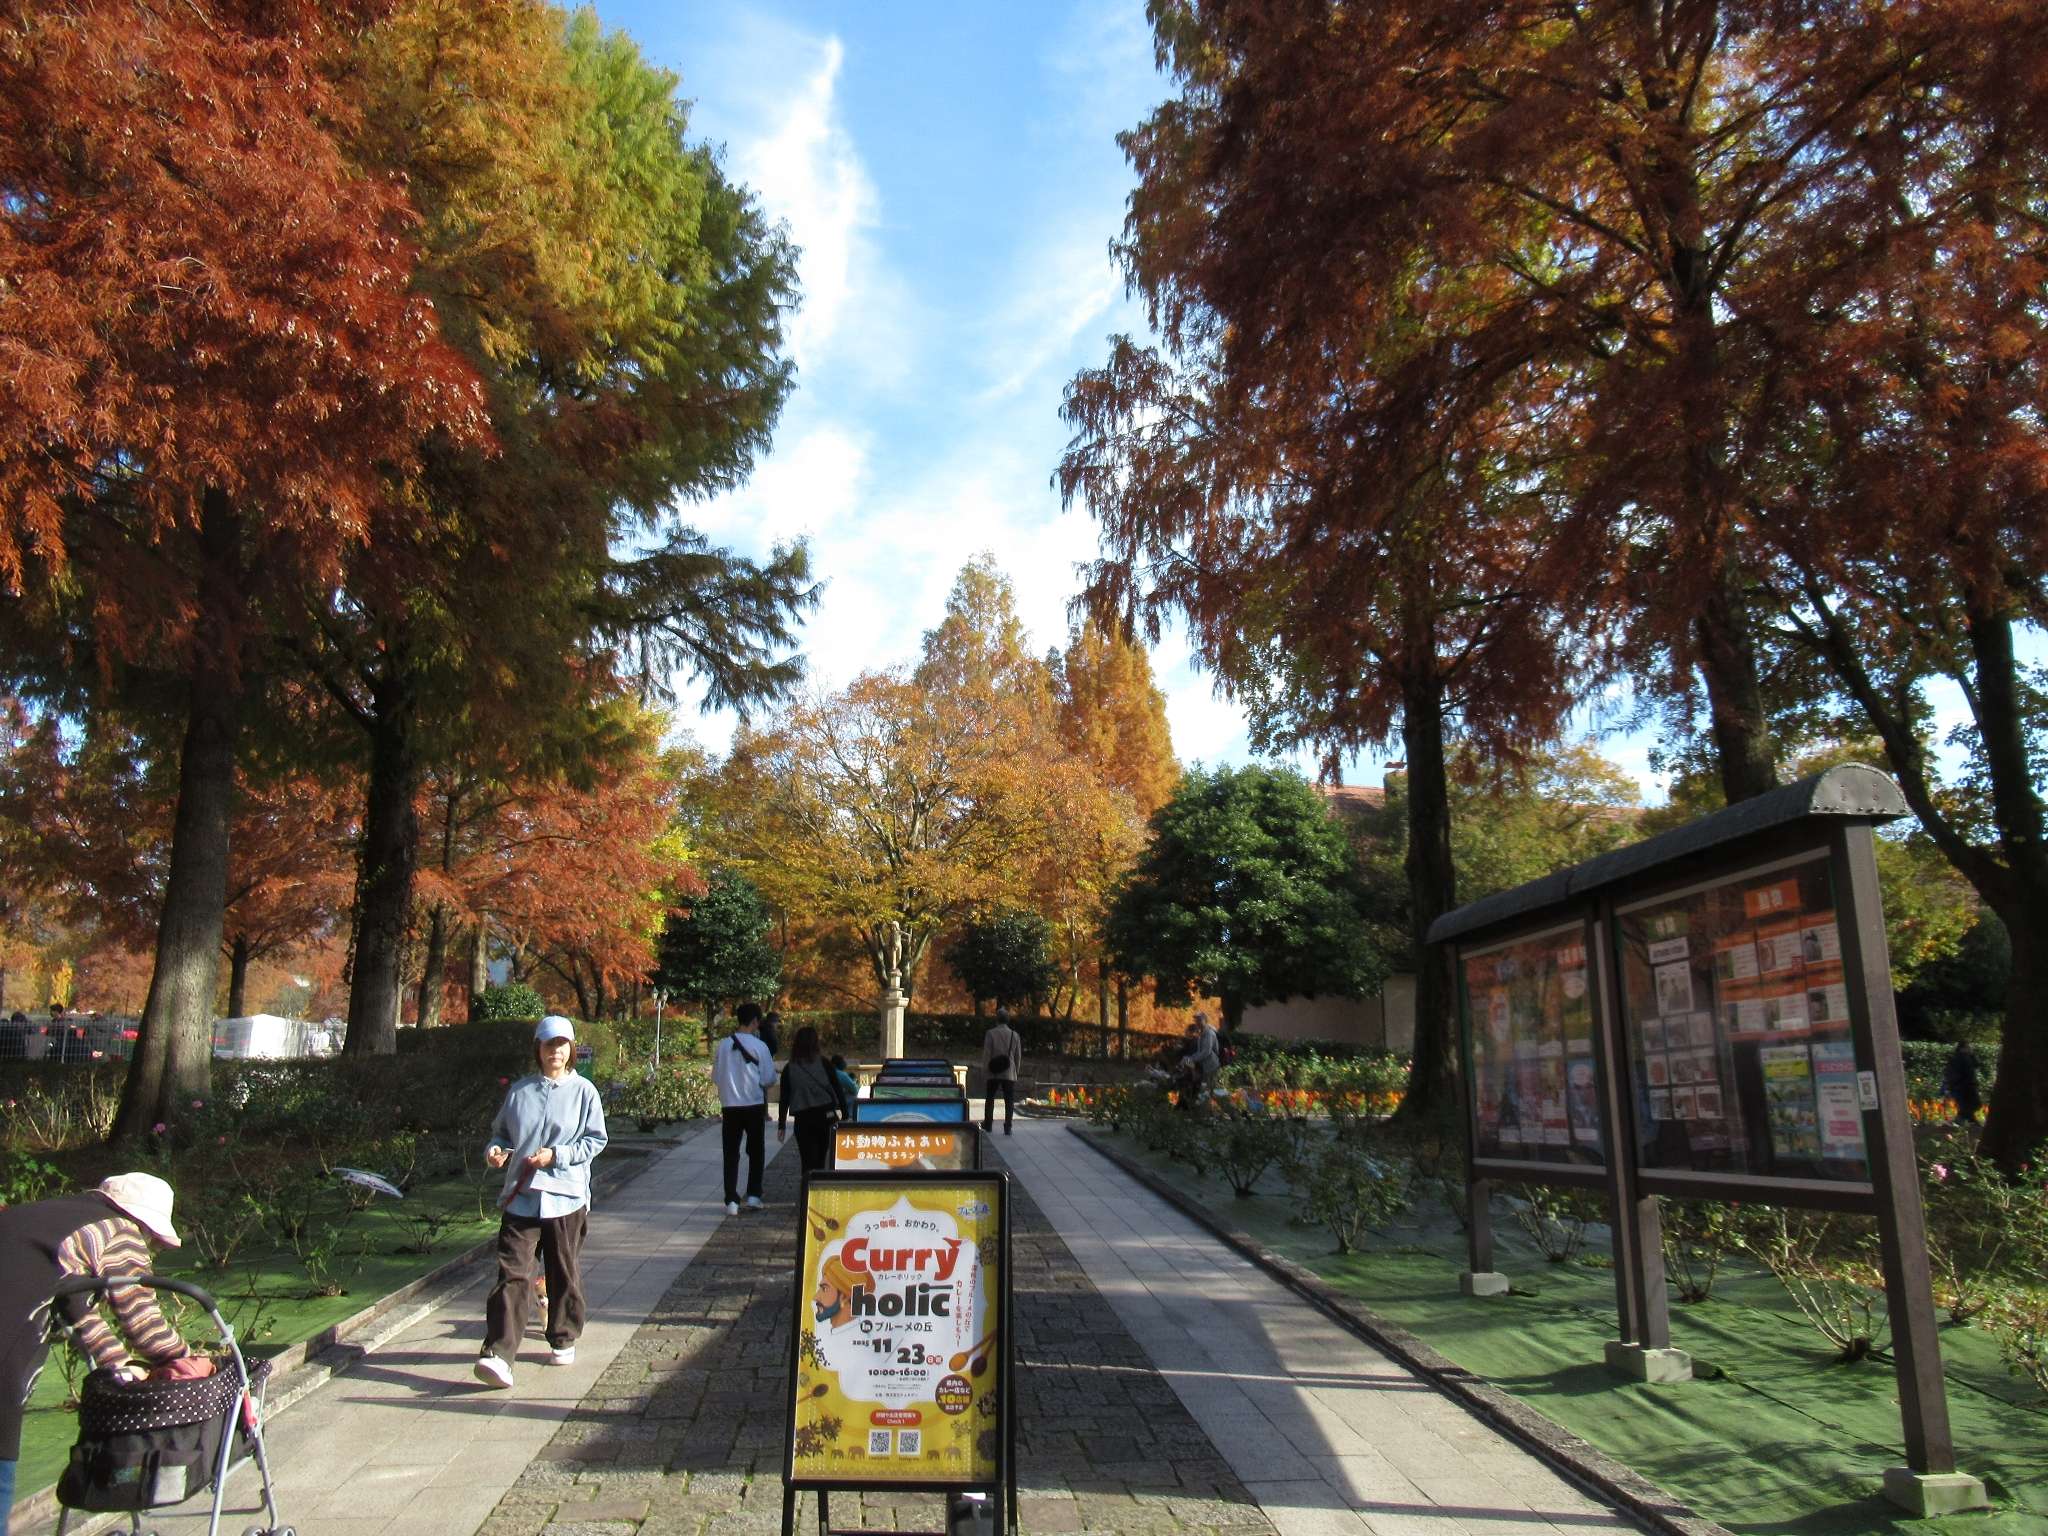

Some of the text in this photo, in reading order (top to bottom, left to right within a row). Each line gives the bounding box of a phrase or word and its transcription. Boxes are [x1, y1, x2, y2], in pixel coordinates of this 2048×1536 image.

[841, 1135, 947, 1149] 小動物ふれあい
[841, 1236, 962, 1281] Curry
[878, 1273, 922, 1281] カレーホリック
[852, 1282, 954, 1317] holic
[875, 1321, 933, 1332] ブルーメの丘
